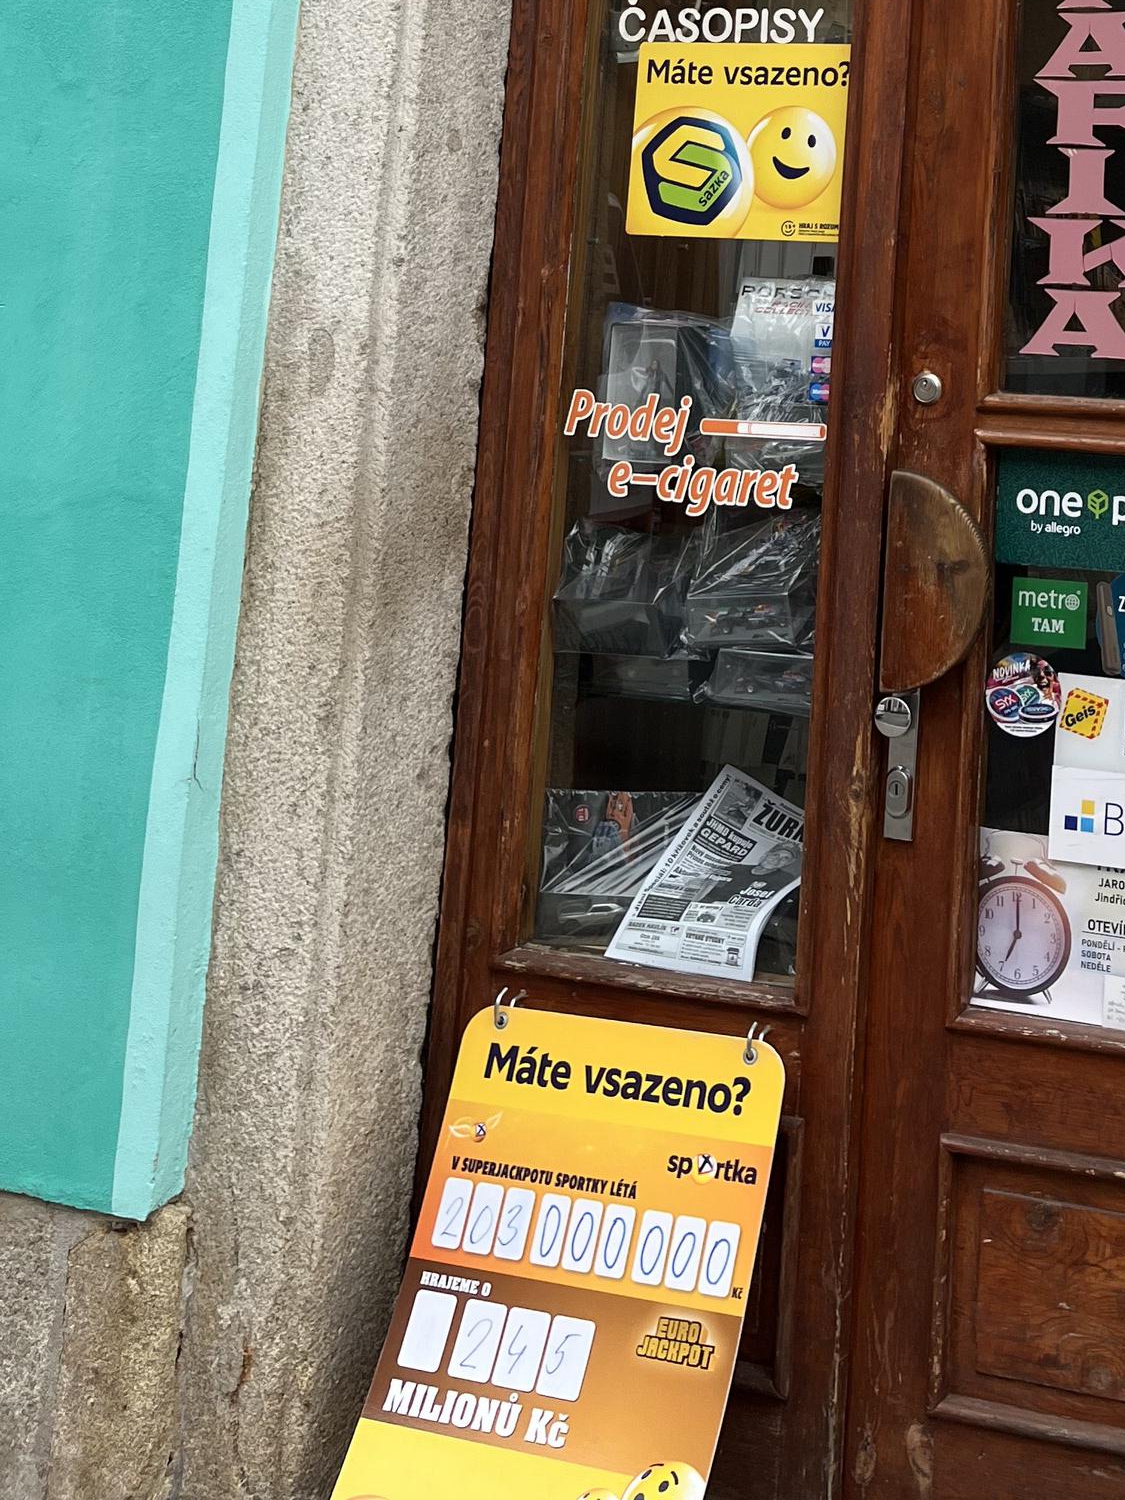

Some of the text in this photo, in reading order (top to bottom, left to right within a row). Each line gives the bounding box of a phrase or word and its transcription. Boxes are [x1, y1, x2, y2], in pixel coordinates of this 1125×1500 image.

[646, 58, 851, 88] Máte vsazeno?
[698, 169, 731, 208] sazka
[821, 325, 831, 338] V
[564, 388, 692, 456] Prodej
[607, 454, 799, 517] e-cigaret
[1016, 488, 1082, 518] one
[1030, 520, 1081, 537] by allegro
[1018, 589, 1080, 611] metro
[1031, 617, 1065, 634] TAM
[993, 659, 1031, 680] NOVINKA
[1065, 704, 1097, 728] Geis
[700, 828, 749, 857] GEPARD
[740, 885, 775, 900] Josef
[1081, 937, 1115, 952] PONDĚLÍ
[1081, 950, 1111, 961] SOBOTA
[1080, 960, 1111, 973] NEDĚLE
[483, 1042, 752, 1116] Máte vsazeno?
[451, 1156, 637, 1199] V SUPERJACKPOTU SPORTKY LÉTÁ
[666, 1151, 758, 1187] sportka
[420, 1271, 492, 1297] HRAJEME O
[731, 1286, 743, 1300] Kč
[657, 1317, 703, 1344] EURO
[460, 1318, 581, 1375] 245
[637, 1338, 715, 1370] JACKPOT
[383, 1378, 569, 1449] MILIONŮ Kč
